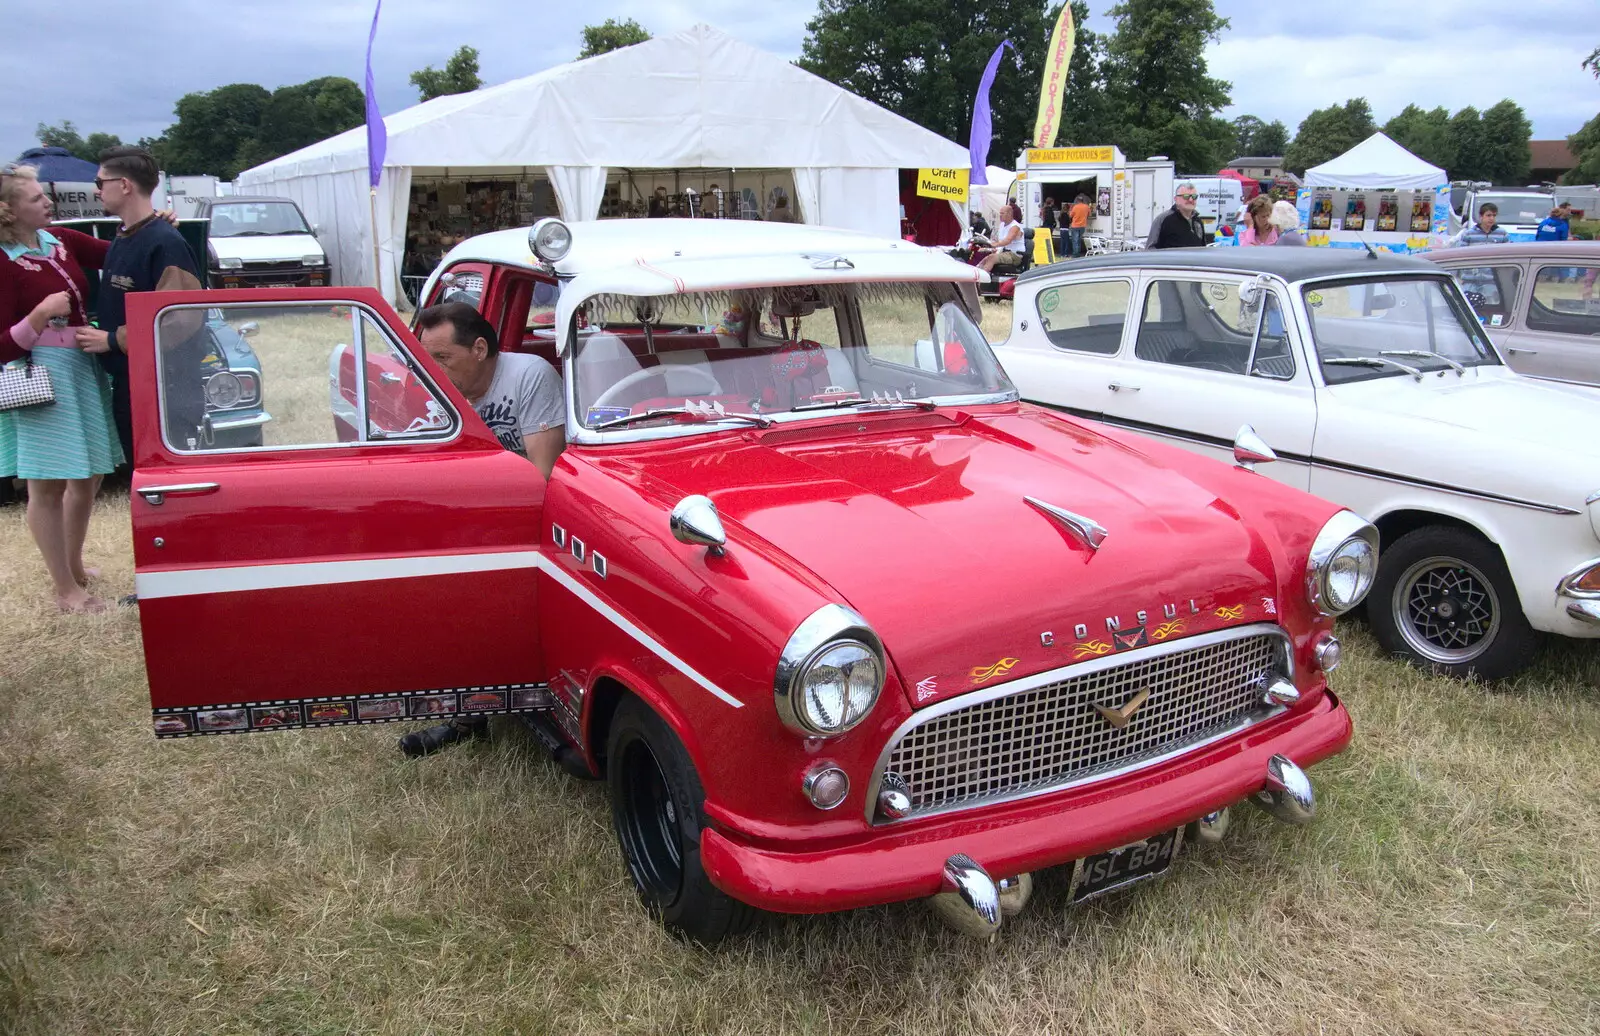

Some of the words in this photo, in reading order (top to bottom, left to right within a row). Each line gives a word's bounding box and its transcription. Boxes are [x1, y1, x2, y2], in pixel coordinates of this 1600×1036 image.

[1042, 151, 1064, 161] JACKET
[1066, 150, 1098, 160] POTATOES
[931, 168, 956, 179] Craft
[921, 180, 963, 195] Marquee
[1040, 599, 1200, 647] CONSUL
[1128, 837, 1173, 871] 684
